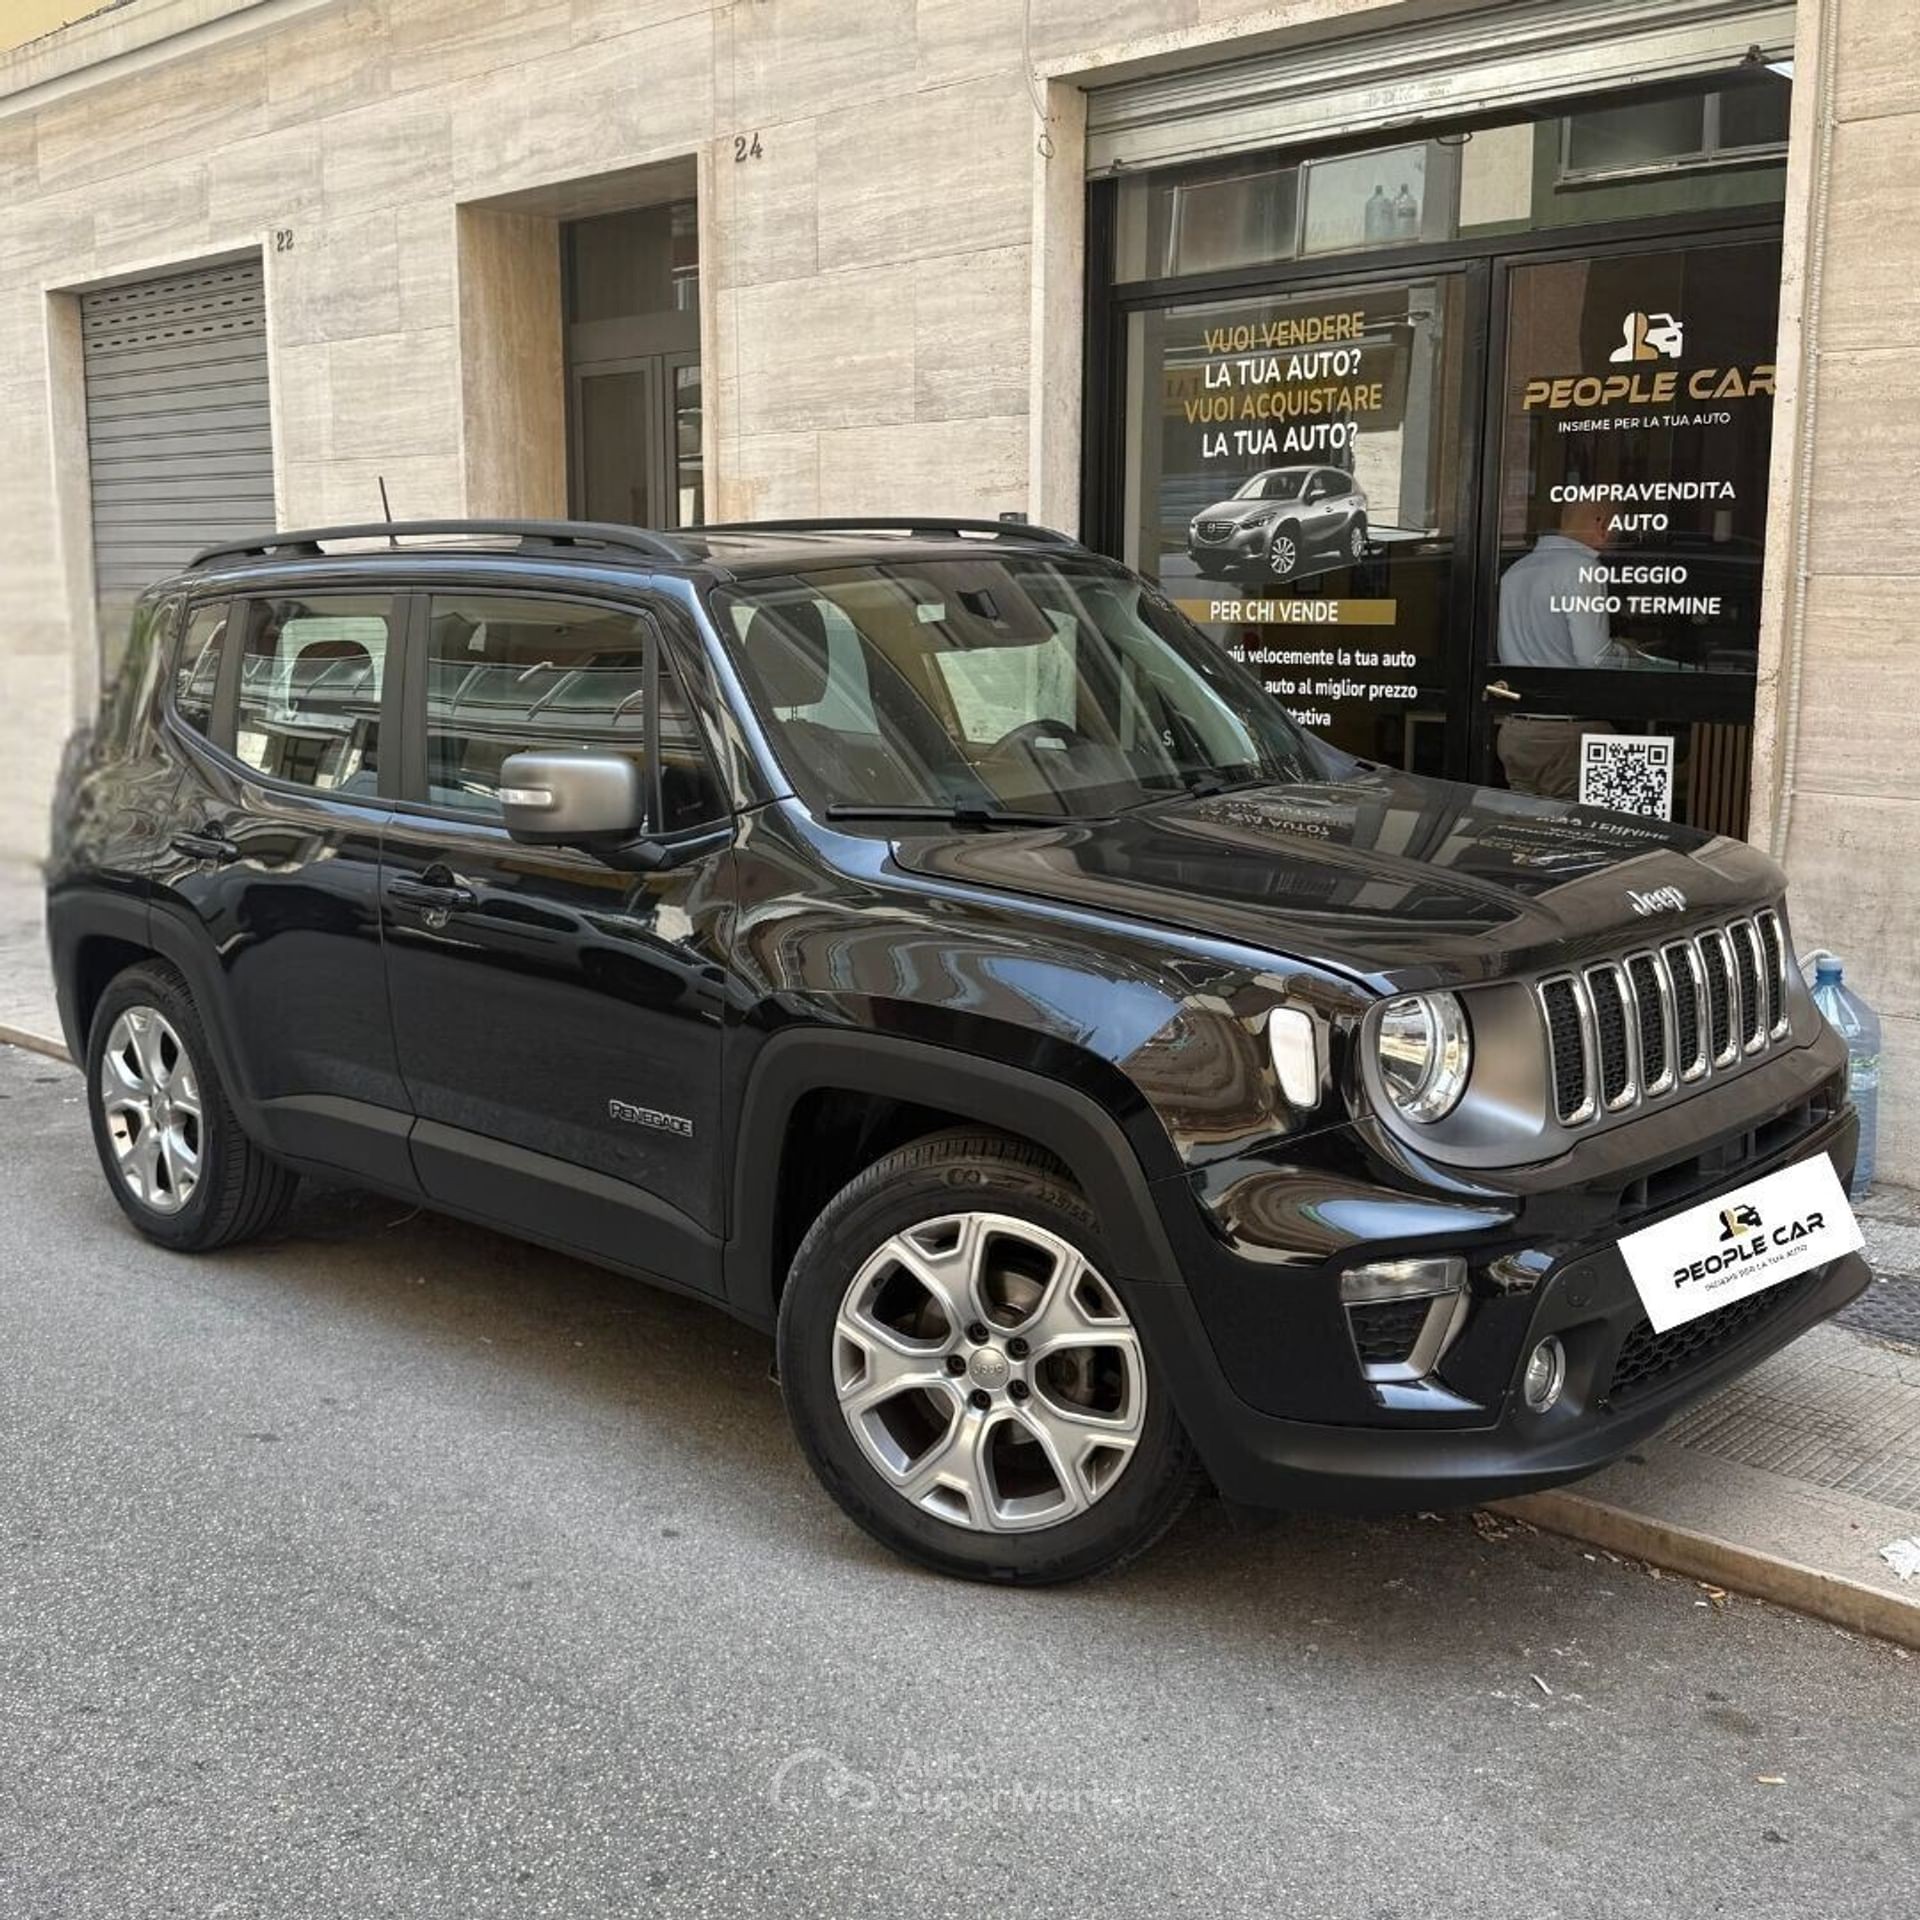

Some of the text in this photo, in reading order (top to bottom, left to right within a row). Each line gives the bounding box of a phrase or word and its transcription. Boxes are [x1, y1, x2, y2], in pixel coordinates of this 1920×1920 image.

[734, 131, 764, 163] 24
[276, 229, 294, 252] 22
[1204, 311, 1365, 354] VUOI VENDERE
[1205, 362, 1231, 389] LA
[1236, 357, 1282, 385] TUA
[1287, 349, 1362, 381] AUTO?
[1523, 364, 1777, 410] PEOPLE CAR
[1185, 384, 1383, 425] VUOI ACQUISTARE
[1558, 412, 1731, 433] INSIEME PER LA TUA AUTO
[1202, 421, 1359, 458] LA TUA AUTO?
[1550, 481, 1736, 502] COMPRAVENDITA
[1607, 513, 1668, 532] AUTO
[1578, 565, 1688, 585] NOLEGGIO
[1210, 601, 1338, 622] PER CHI VENDE
[1550, 595, 1721, 615] LUNGO TERMINE
[1248, 645, 1334, 667] velocemente
[1337, 648, 1351, 666] la
[1354, 650, 1379, 668] tua
[1382, 651, 1416, 668] auto
[1264, 676, 1418, 702] auto al miglior prezzo
[1626, 885, 1686, 916] Jeep
[609, 1099, 693, 1137] RENEGADE
